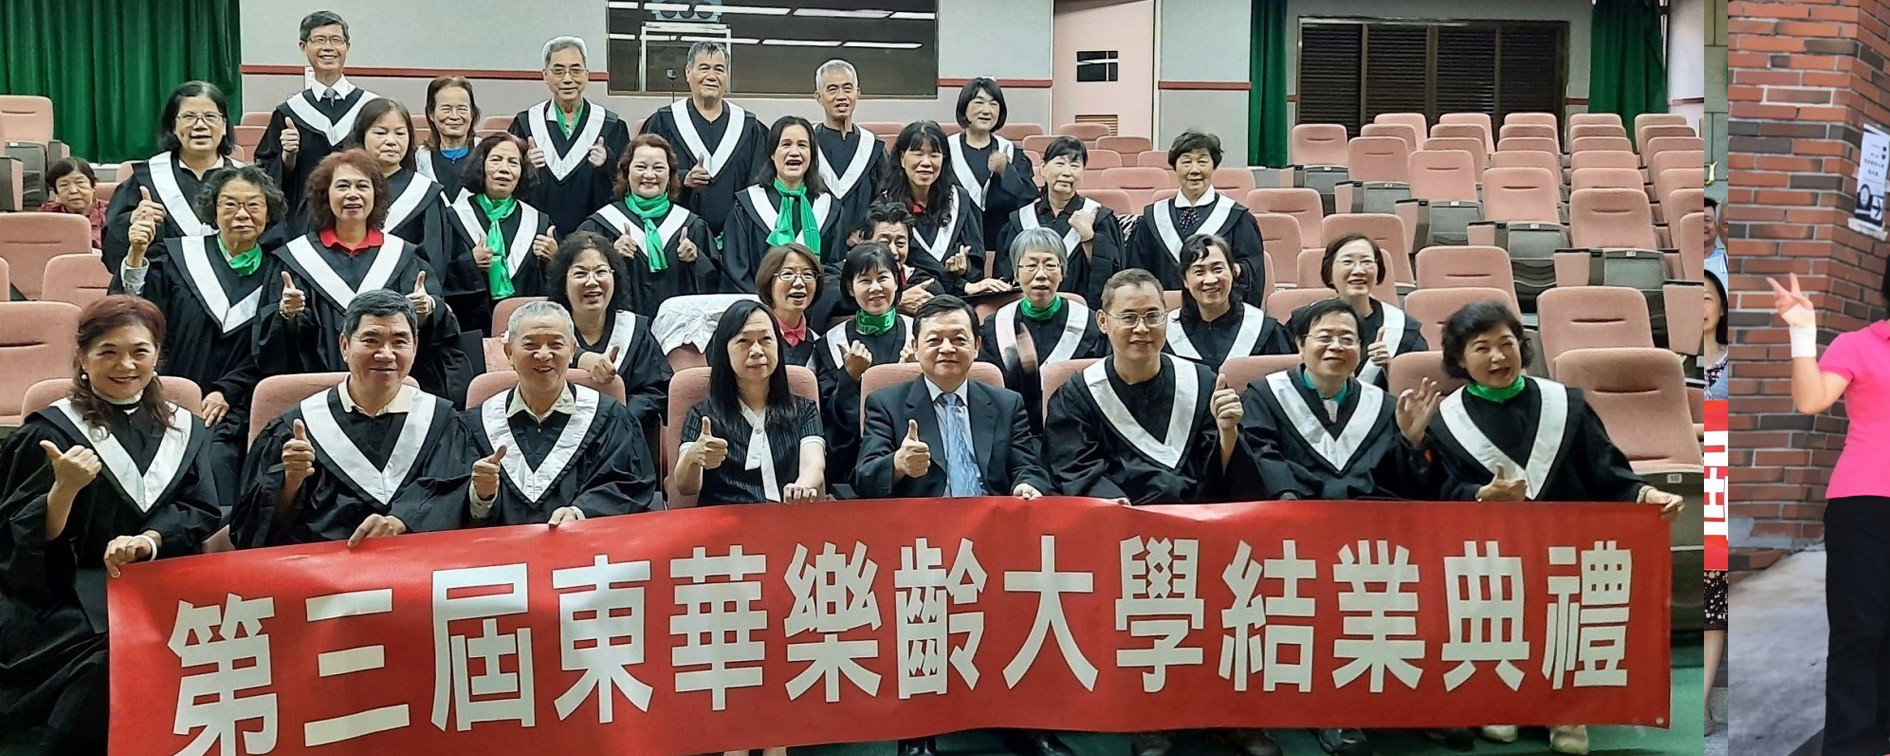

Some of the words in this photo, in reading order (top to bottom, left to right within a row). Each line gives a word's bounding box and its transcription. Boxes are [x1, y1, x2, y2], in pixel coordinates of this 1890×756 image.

[167, 535, 1632, 756] 第三屆東華樂齡大學結業典禮
